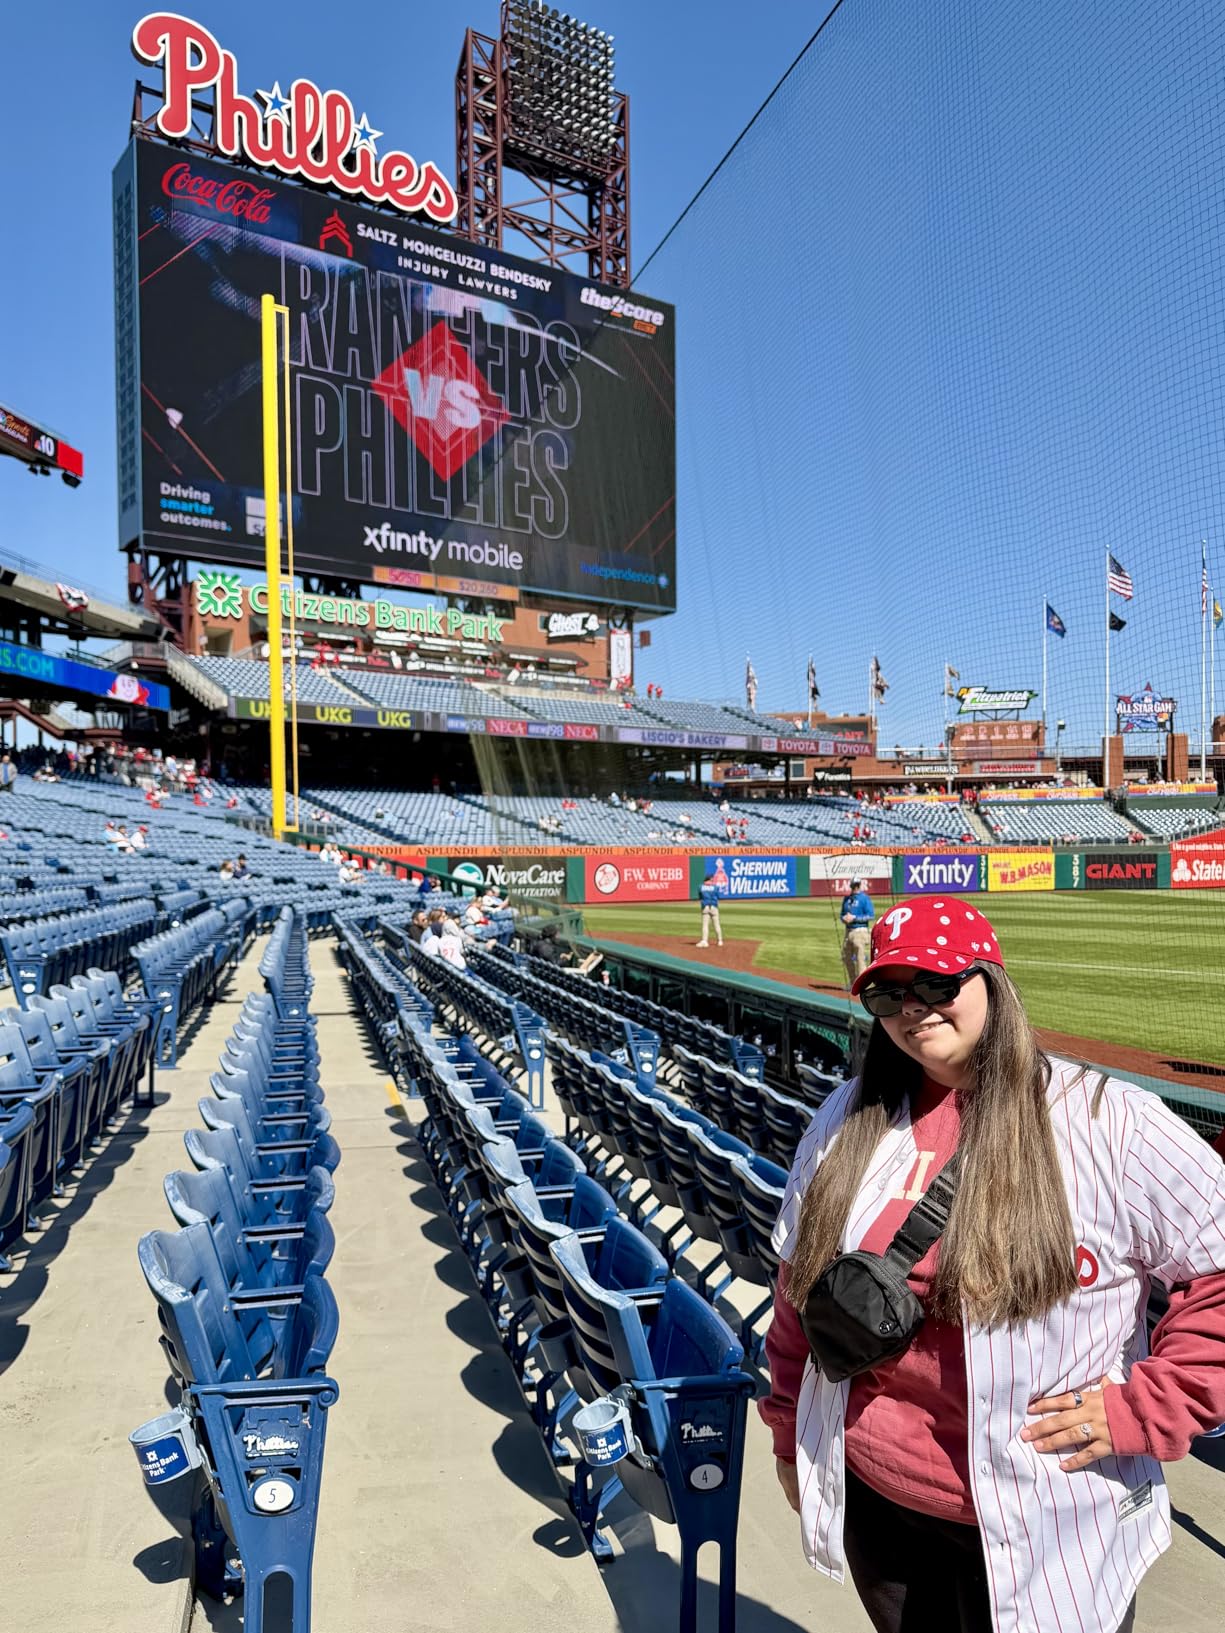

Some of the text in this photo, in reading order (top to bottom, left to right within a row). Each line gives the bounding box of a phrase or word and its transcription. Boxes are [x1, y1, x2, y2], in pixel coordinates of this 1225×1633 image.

[132, 12, 458, 222] Phillies
[161, 162, 277, 225] Coca-Cola
[356, 223, 552, 292] SALTZ MONGELUZZI BENDESKY
[398, 256, 518, 300] INJURY LAWYERS
[403, 367, 481, 429] VS
[40, 435, 55, 457] 10
[160, 482, 211, 504] Driving
[160, 498, 215, 516] smarter
[160, 512, 232, 533] outcomes.
[363, 522, 523, 570] xfinity mobile
[249, 583, 504, 642] Ctizens Bank Park
[0, 648, 55, 678] S.COM
[315, 705, 352, 723] UKG
[377, 710, 411, 728] UKG
[1116, 702, 1132, 714] ALL
[1132, 702, 1154, 713] STAR
[488, 718, 526, 736] NECA
[565, 724, 599, 740] NECA
[641, 731, 727, 745] LISCIO'S BAKERY
[780, 740, 871, 754] TOYOTA TOYOTA
[416, 847, 478, 855] ASPLUNDH
[491, 847, 548, 855] ASPLUNDH
[559, 847, 613, 855] ASPLUNDH
[623, 847, 673, 855] ASPLUNDH
[484, 864, 566, 886] NovaCare
[623, 867, 684, 882] F.W. WEBB
[731, 859, 787, 877] SHERWIN
[908, 857, 974, 889] xfinity
[1018, 862, 1052, 880] MASON
[1086, 863, 1156, 879] GIANT
[1192, 858, 1222, 881] State
[636, 881, 671, 890] COMPANY
[834, 879, 869, 892] LAR
[885, 907, 913, 940] P
[243, 1434, 299, 1452] Phillies
[141, 1451, 179, 1471] tizens Bank
[149, 1467, 165, 1477] Park
[702, 1469, 708, 1484] 4
[268, 1488, 277, 1504] 5
